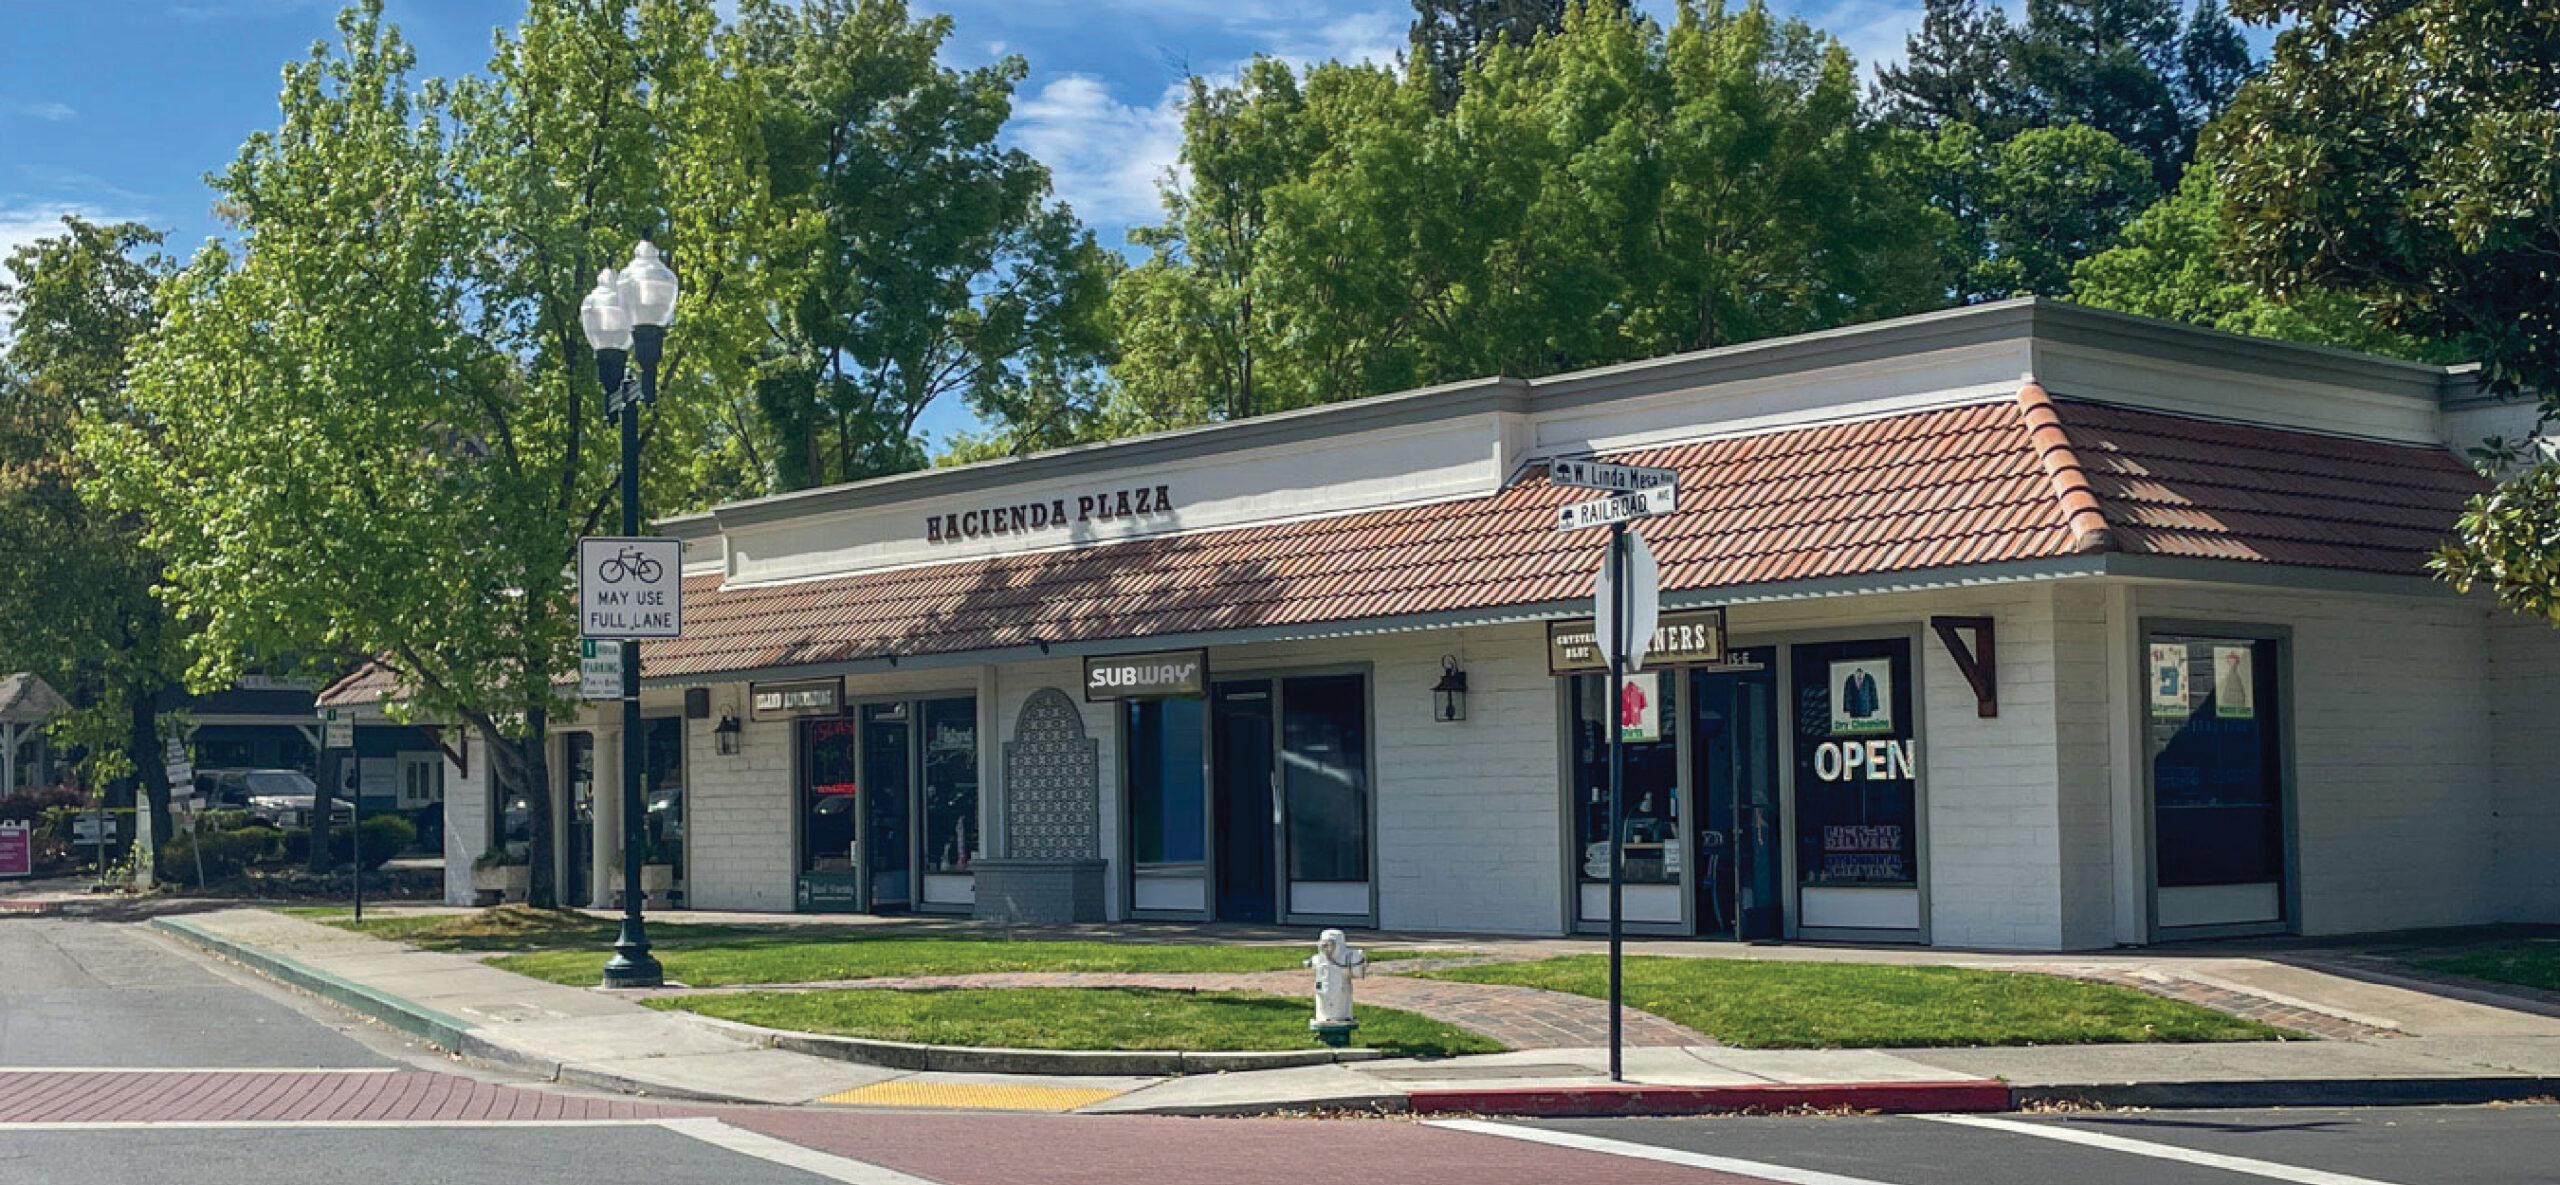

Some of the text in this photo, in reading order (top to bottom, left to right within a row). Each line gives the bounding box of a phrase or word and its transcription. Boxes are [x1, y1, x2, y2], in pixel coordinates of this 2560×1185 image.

[1591, 465, 1626, 488] Linda
[1630, 468, 1659, 489] Mesa
[926, 484, 1173, 543] HACIENDA PLAZA
[1580, 493, 1648, 525] RAILROAD
[597, 590, 664, 606] MAY USE
[590, 611, 673, 629] FULL LANE
[1645, 623, 1706, 652] NERS
[583, 661, 619, 674] PARKING
[1089, 663, 1197, 688] SUBWAY
[1814, 740, 1916, 782] OPEN
